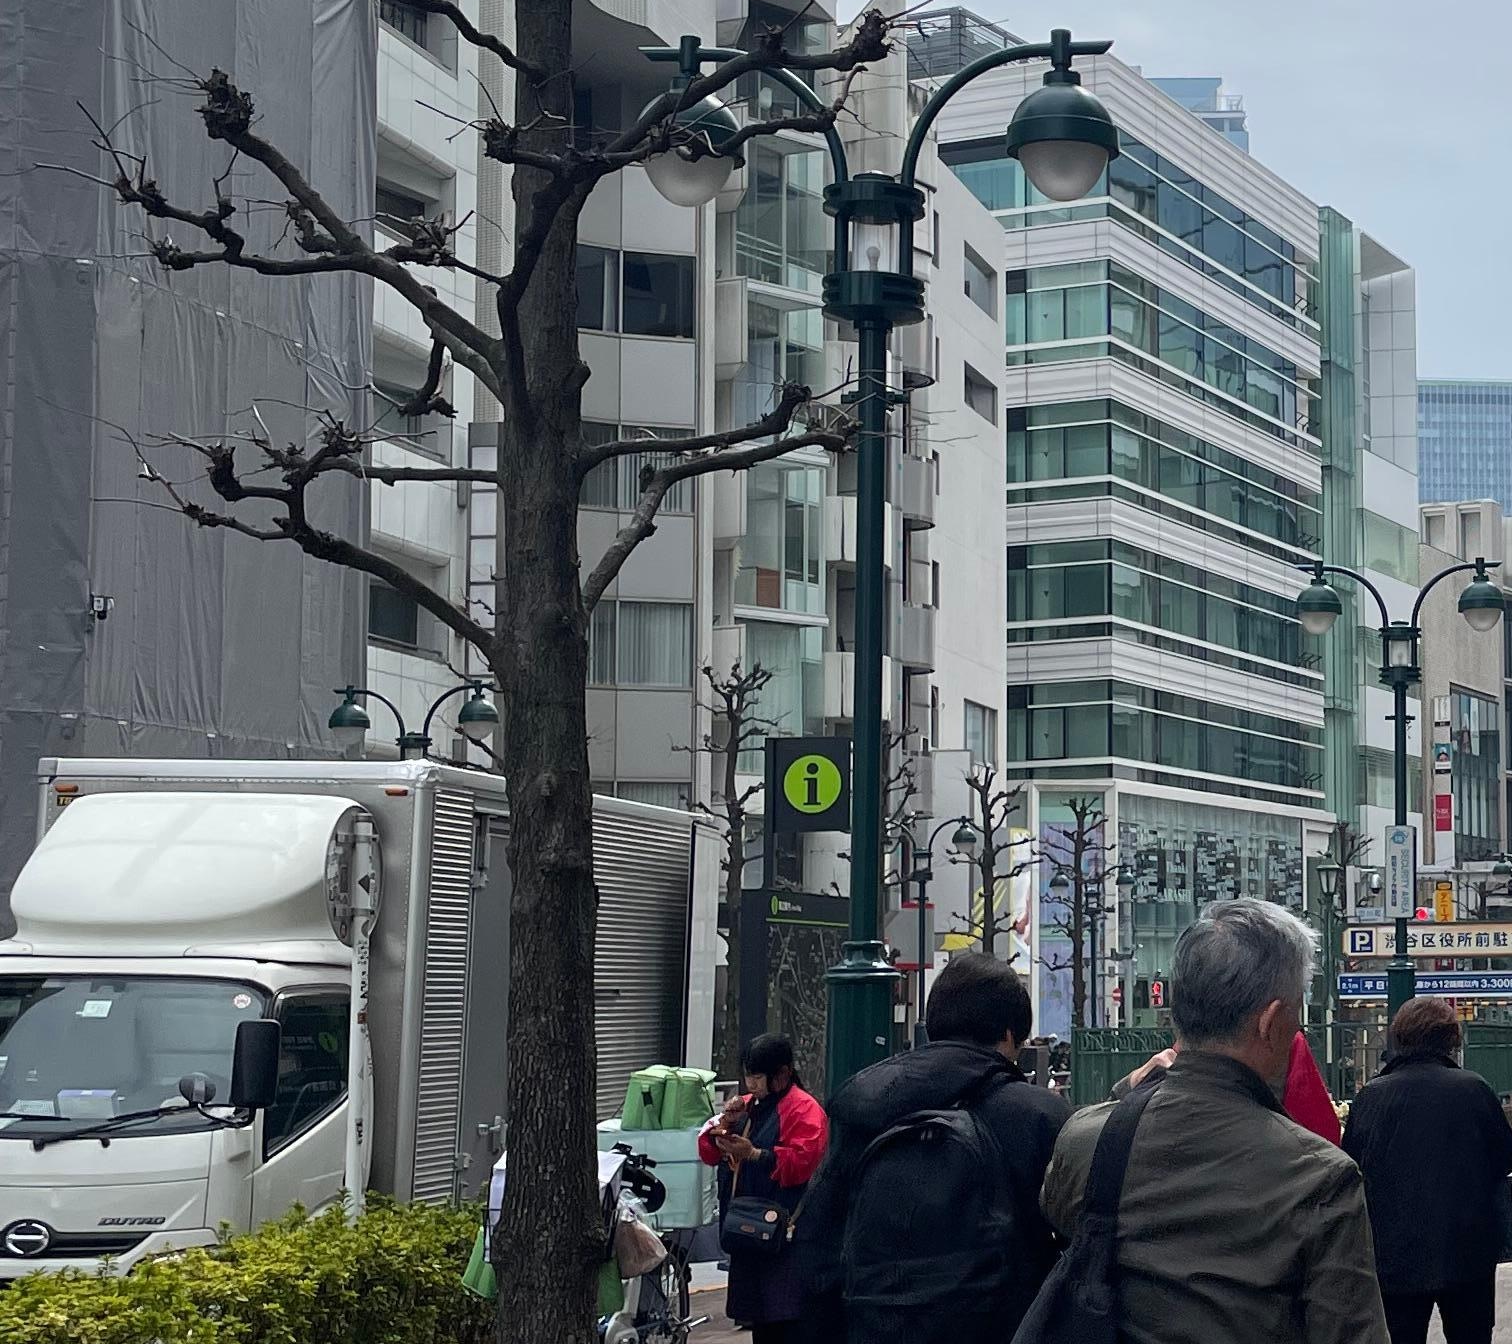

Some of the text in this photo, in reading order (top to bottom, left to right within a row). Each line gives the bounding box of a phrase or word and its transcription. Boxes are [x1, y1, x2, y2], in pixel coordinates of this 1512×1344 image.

[1401, 848, 1410, 914] SECURITY AREA
[1355, 932, 1370, 951] P
